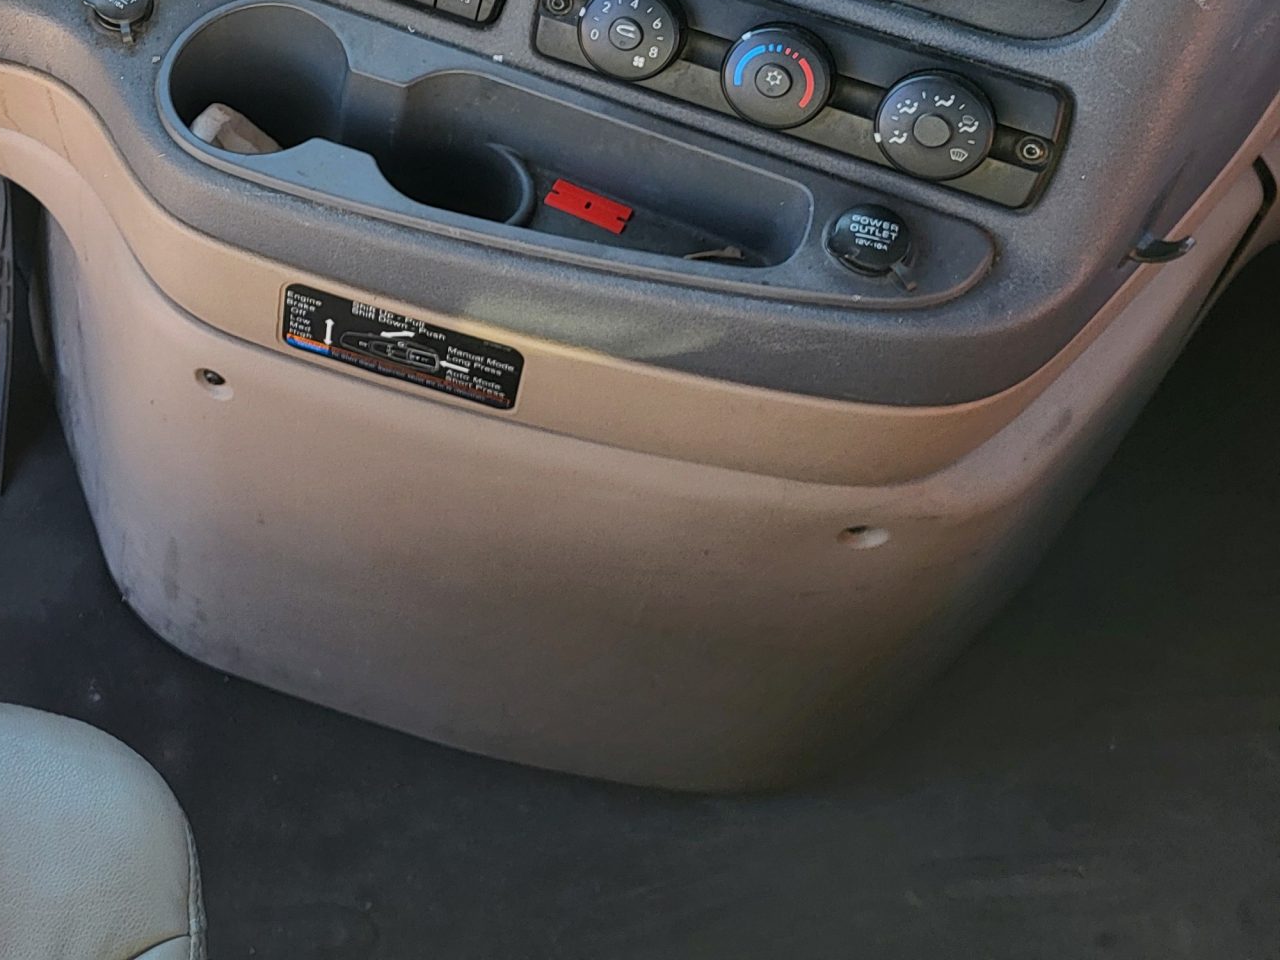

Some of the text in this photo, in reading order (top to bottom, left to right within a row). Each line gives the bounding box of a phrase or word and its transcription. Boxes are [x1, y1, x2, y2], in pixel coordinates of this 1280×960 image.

[602, 2, 611, 13] 2
[630, 0, 639, 9] 4
[652, 18, 661, 29] 6
[591, 29, 599, 40] 0
[649, 46, 658, 58] 8
[852, 215, 899, 232] POWER
[850, 223, 898, 240] OUTLET
[287, 290, 322, 306] Engine
[287, 298, 315, 312] Brake
[291, 307, 306, 316] Off
[290, 314, 310, 324] Low
[290, 321, 310, 332] Med
[379, 315, 407, 329] Down
[419, 327, 446, 340] Push
[446, 354, 501, 376] Long Press
[447, 346, 484, 362] Manual
[487, 358, 514, 372] Mode
[446, 369, 501, 390] Auto Mode
